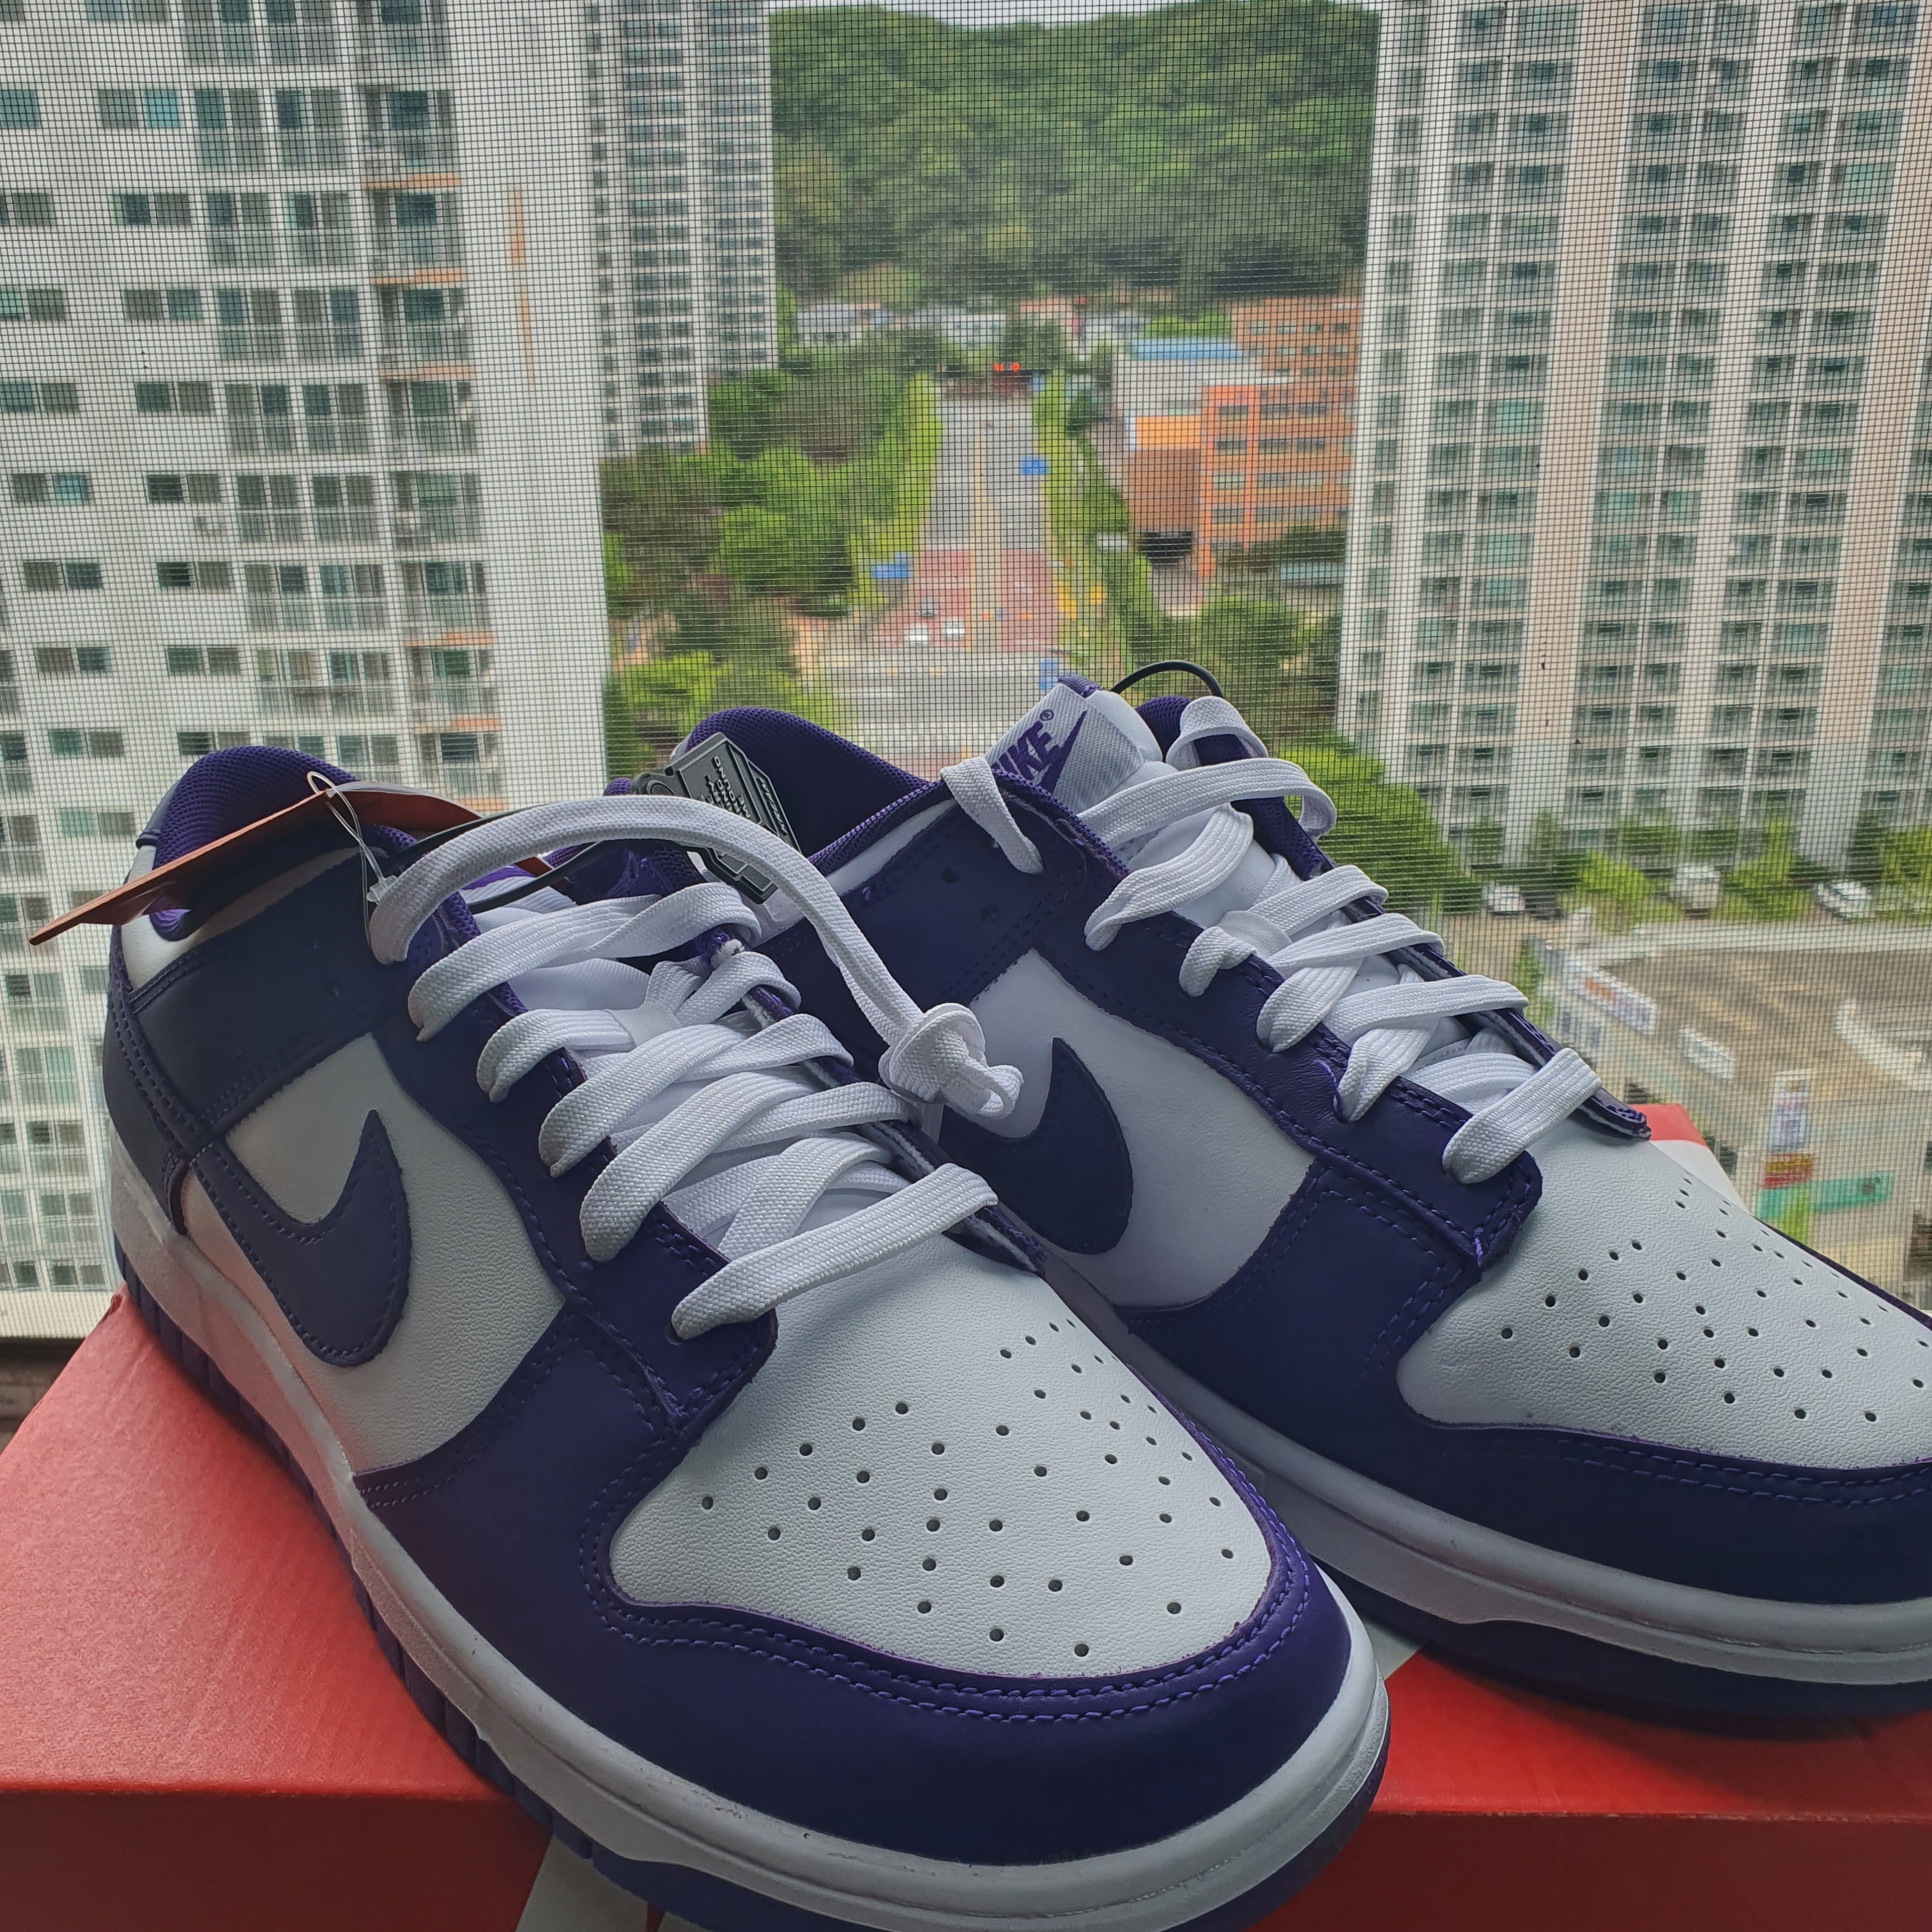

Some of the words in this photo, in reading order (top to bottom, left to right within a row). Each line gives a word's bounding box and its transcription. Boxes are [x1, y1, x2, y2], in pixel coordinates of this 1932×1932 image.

[991, 721, 1059, 781] IKE
[714, 755, 742, 816] ROUND
[739, 794, 751, 818] ME
[758, 777, 788, 834] KREAM
